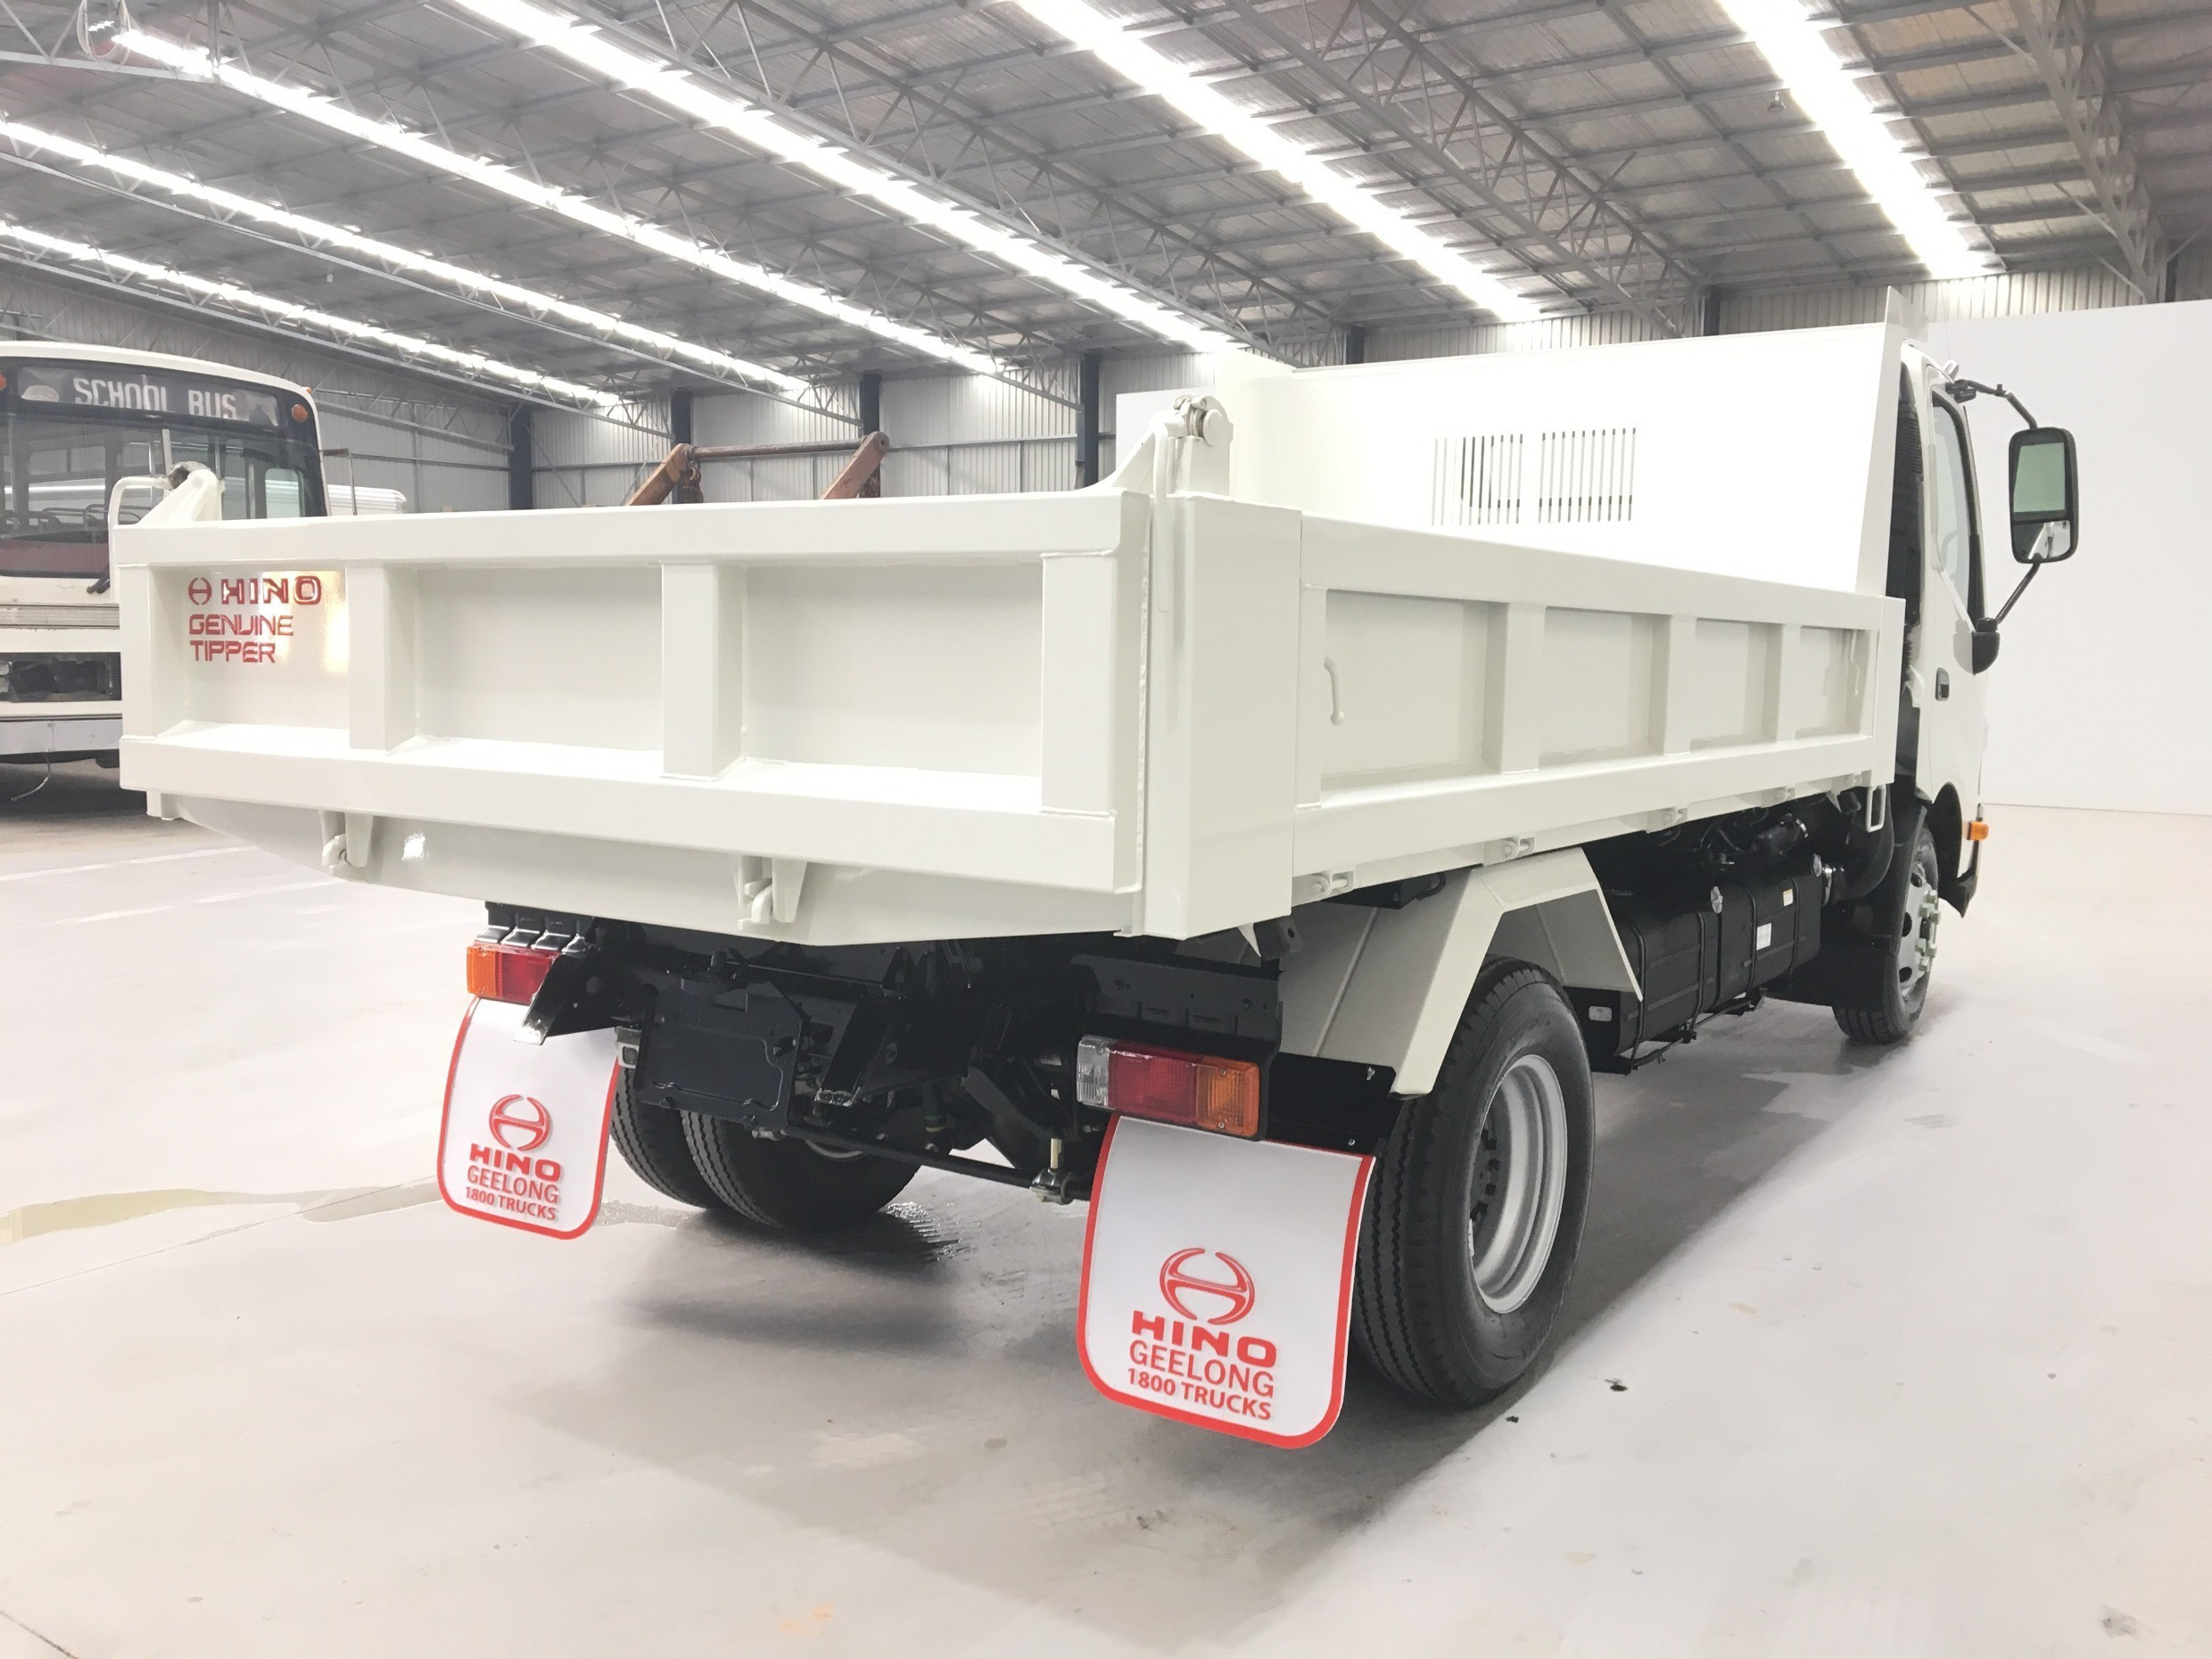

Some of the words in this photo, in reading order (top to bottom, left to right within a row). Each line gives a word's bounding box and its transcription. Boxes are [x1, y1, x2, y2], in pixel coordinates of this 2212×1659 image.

[73, 377, 175, 413] SCHOOL
[187, 389, 237, 421] BUS
[221, 575, 321, 605] HINO
[189, 614, 293, 636] GENUINE
[190, 640, 276, 663] TIPPER
[470, 1143, 561, 1182] HINO
[466, 1186, 495, 1206] 1800
[498, 1194, 556, 1221] TRUCKS
[467, 1165, 558, 1204] GEELONG
[1132, 1310, 1276, 1368] HINO
[1129, 1340, 1275, 1399] GEELONG
[1127, 1368, 1176, 1396] 1800
[1181, 1382, 1271, 1421] TRUCKS
